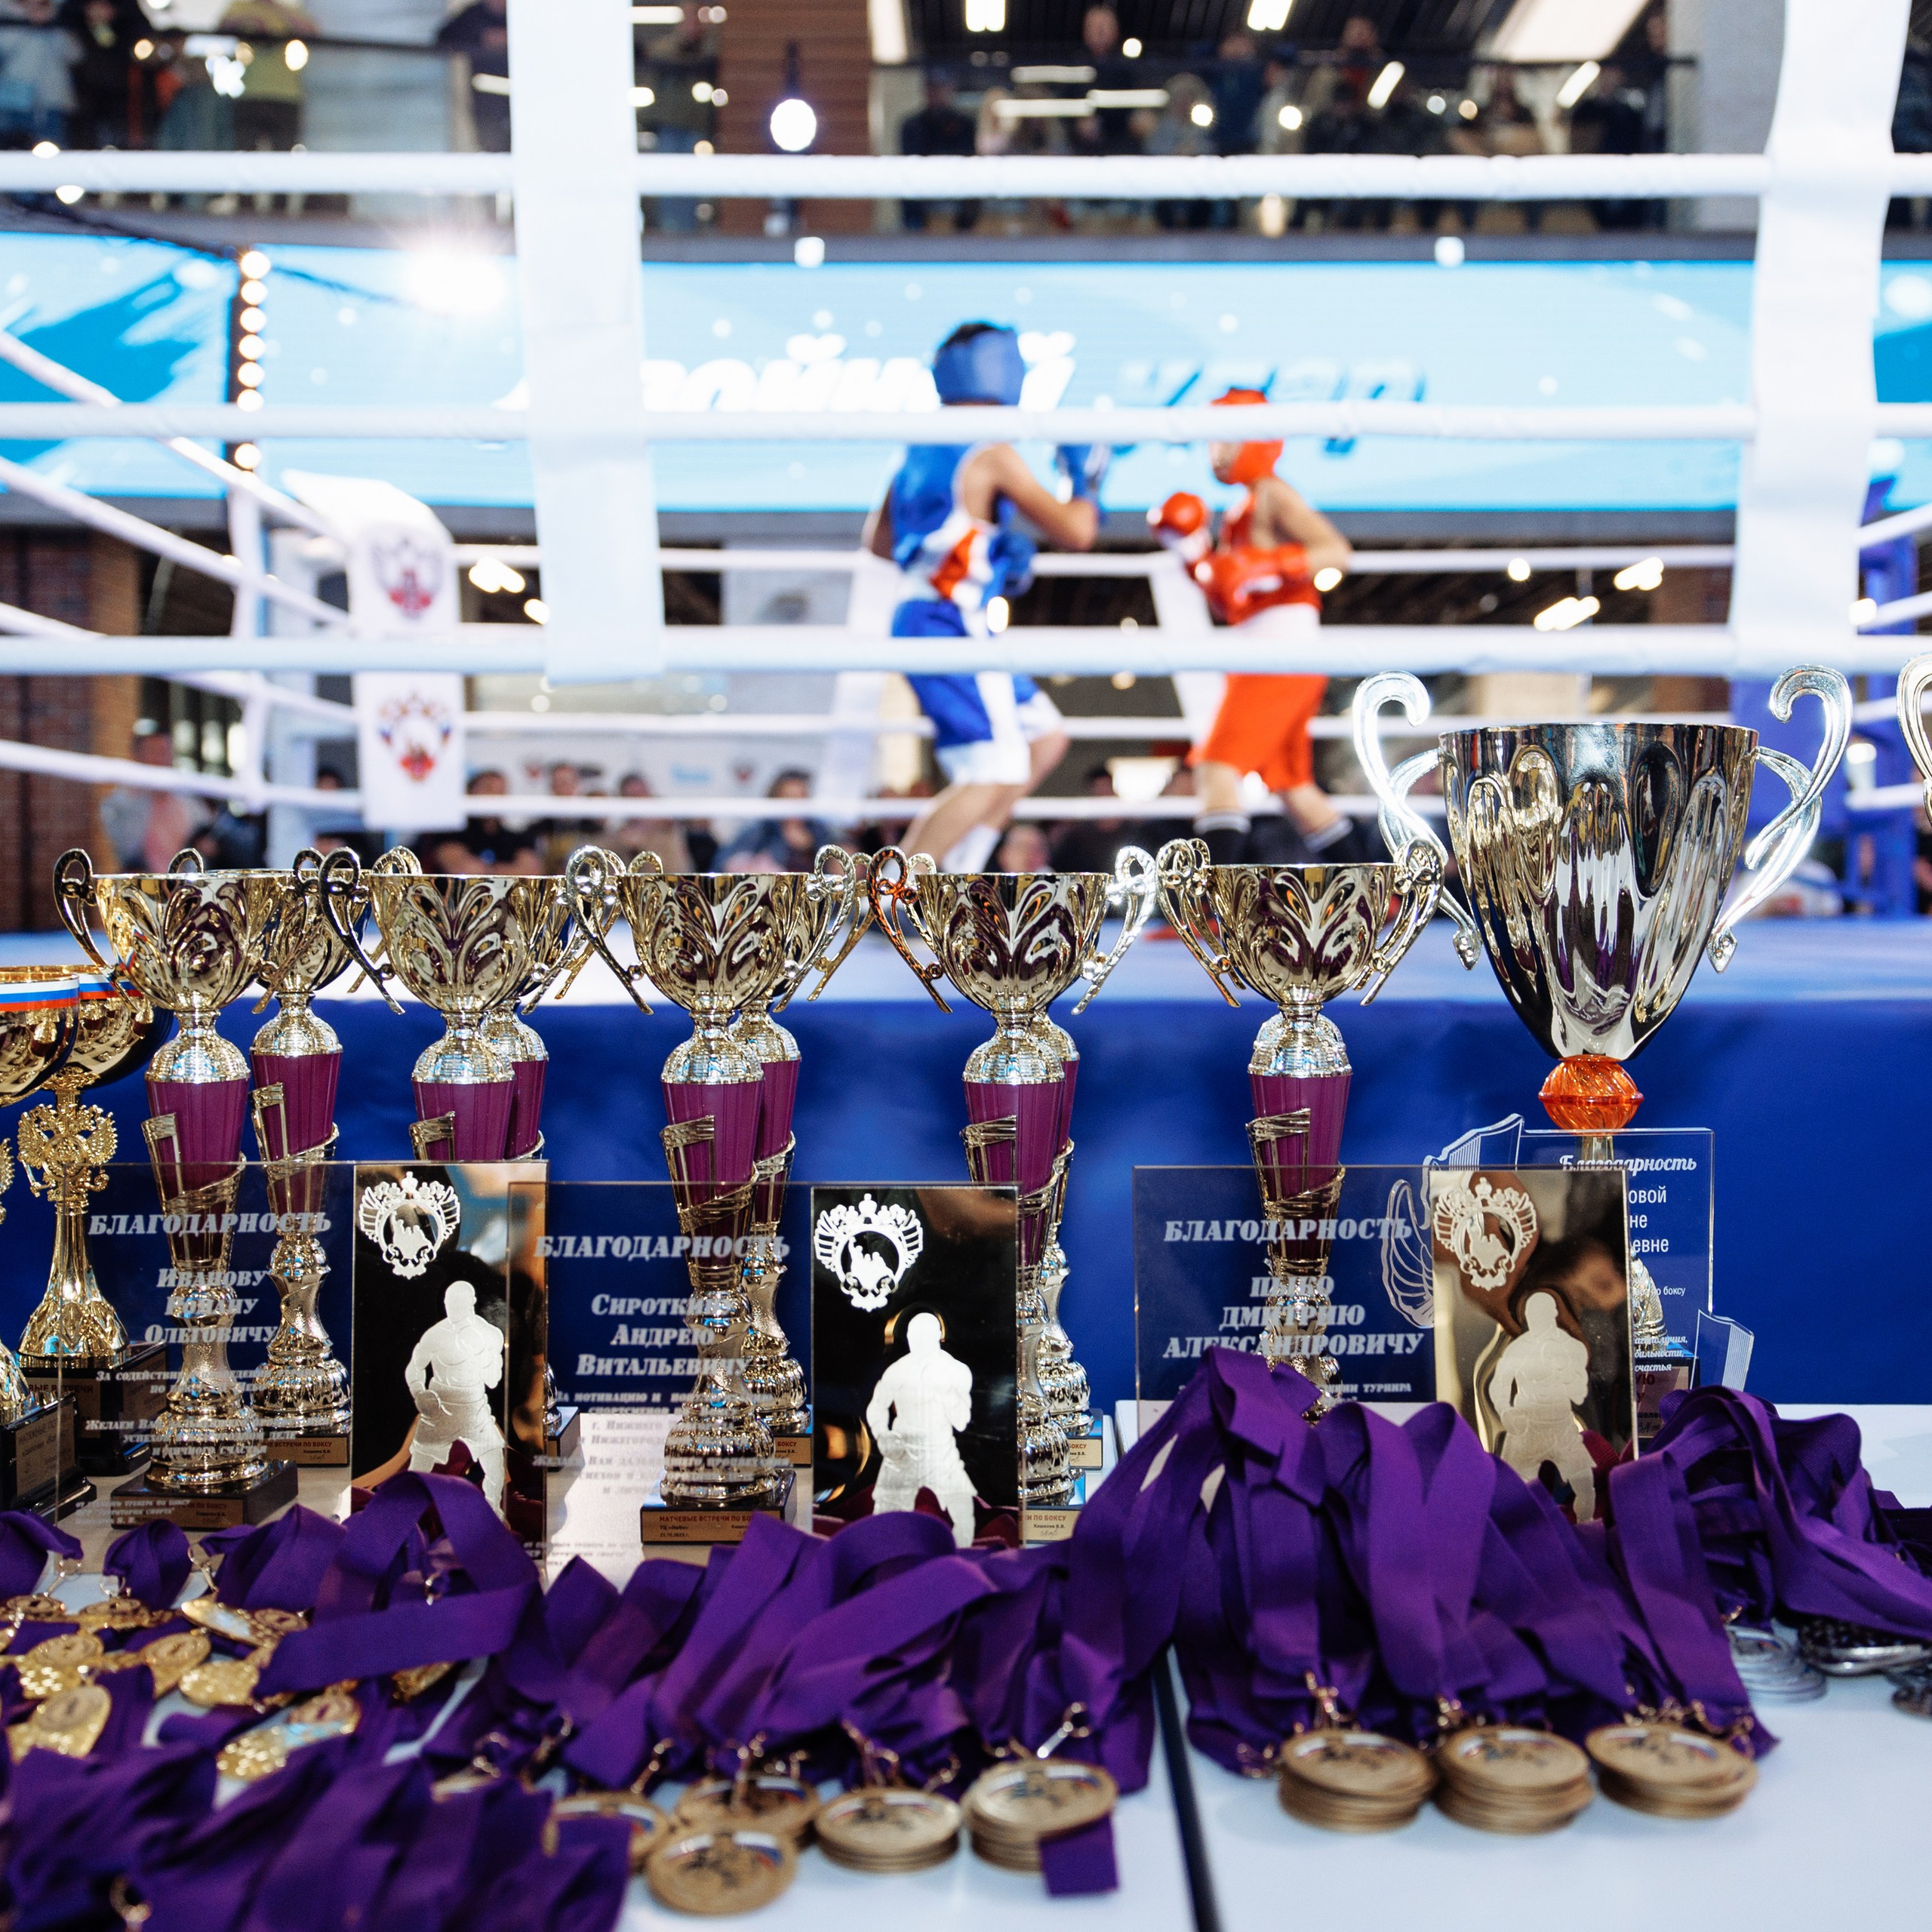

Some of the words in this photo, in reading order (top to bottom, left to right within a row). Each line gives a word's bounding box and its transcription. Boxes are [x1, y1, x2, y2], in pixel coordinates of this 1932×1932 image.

[1628, 1185, 1666, 1204] овой
[88, 1212, 331, 1237] БЛАГОДАРНОСТЬ
[1163, 1219, 1413, 1244] БЛАГОДАРНОСТЬ
[534, 1235, 790, 1262] БЛАГОДАРНОСТЬ
[1632, 1238, 1669, 1253] евне
[1663, 1285, 1686, 1297] боксу
[1218, 1305, 1365, 1331] ДМИТРИЮ
[54, 1384, 94, 1393] ВТРЕЧИ
